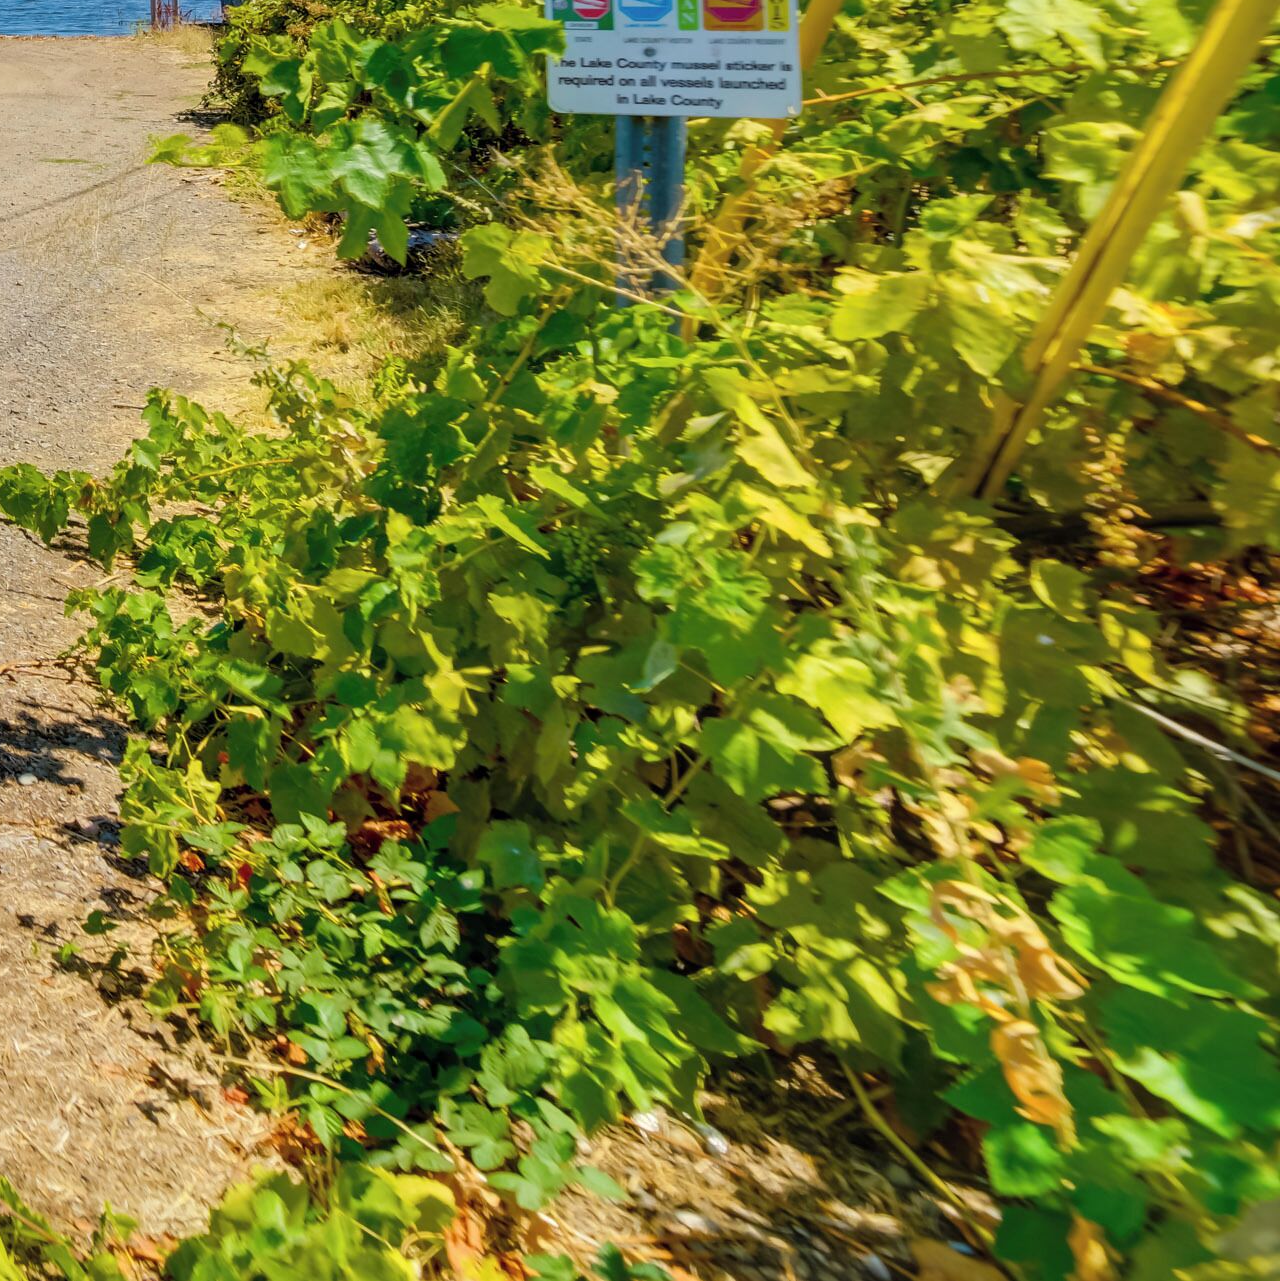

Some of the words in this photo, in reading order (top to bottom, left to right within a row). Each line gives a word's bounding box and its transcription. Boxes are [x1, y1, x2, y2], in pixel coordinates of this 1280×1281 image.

[554, 58, 576, 68] he
[581, 58, 612, 68] Lake
[616, 58, 666, 71] County
[671, 60, 721, 70] mussel
[726, 60, 776, 71] sticker
[780, 61, 793, 71] is
[558, 74, 614, 87] required
[619, 77, 636, 87] on
[641, 75, 657, 87] all
[660, 77, 715, 88] vessels
[720, 78, 787, 90] launched
[633, 94, 665, 105] Lake
[670, 94, 723, 109] County
